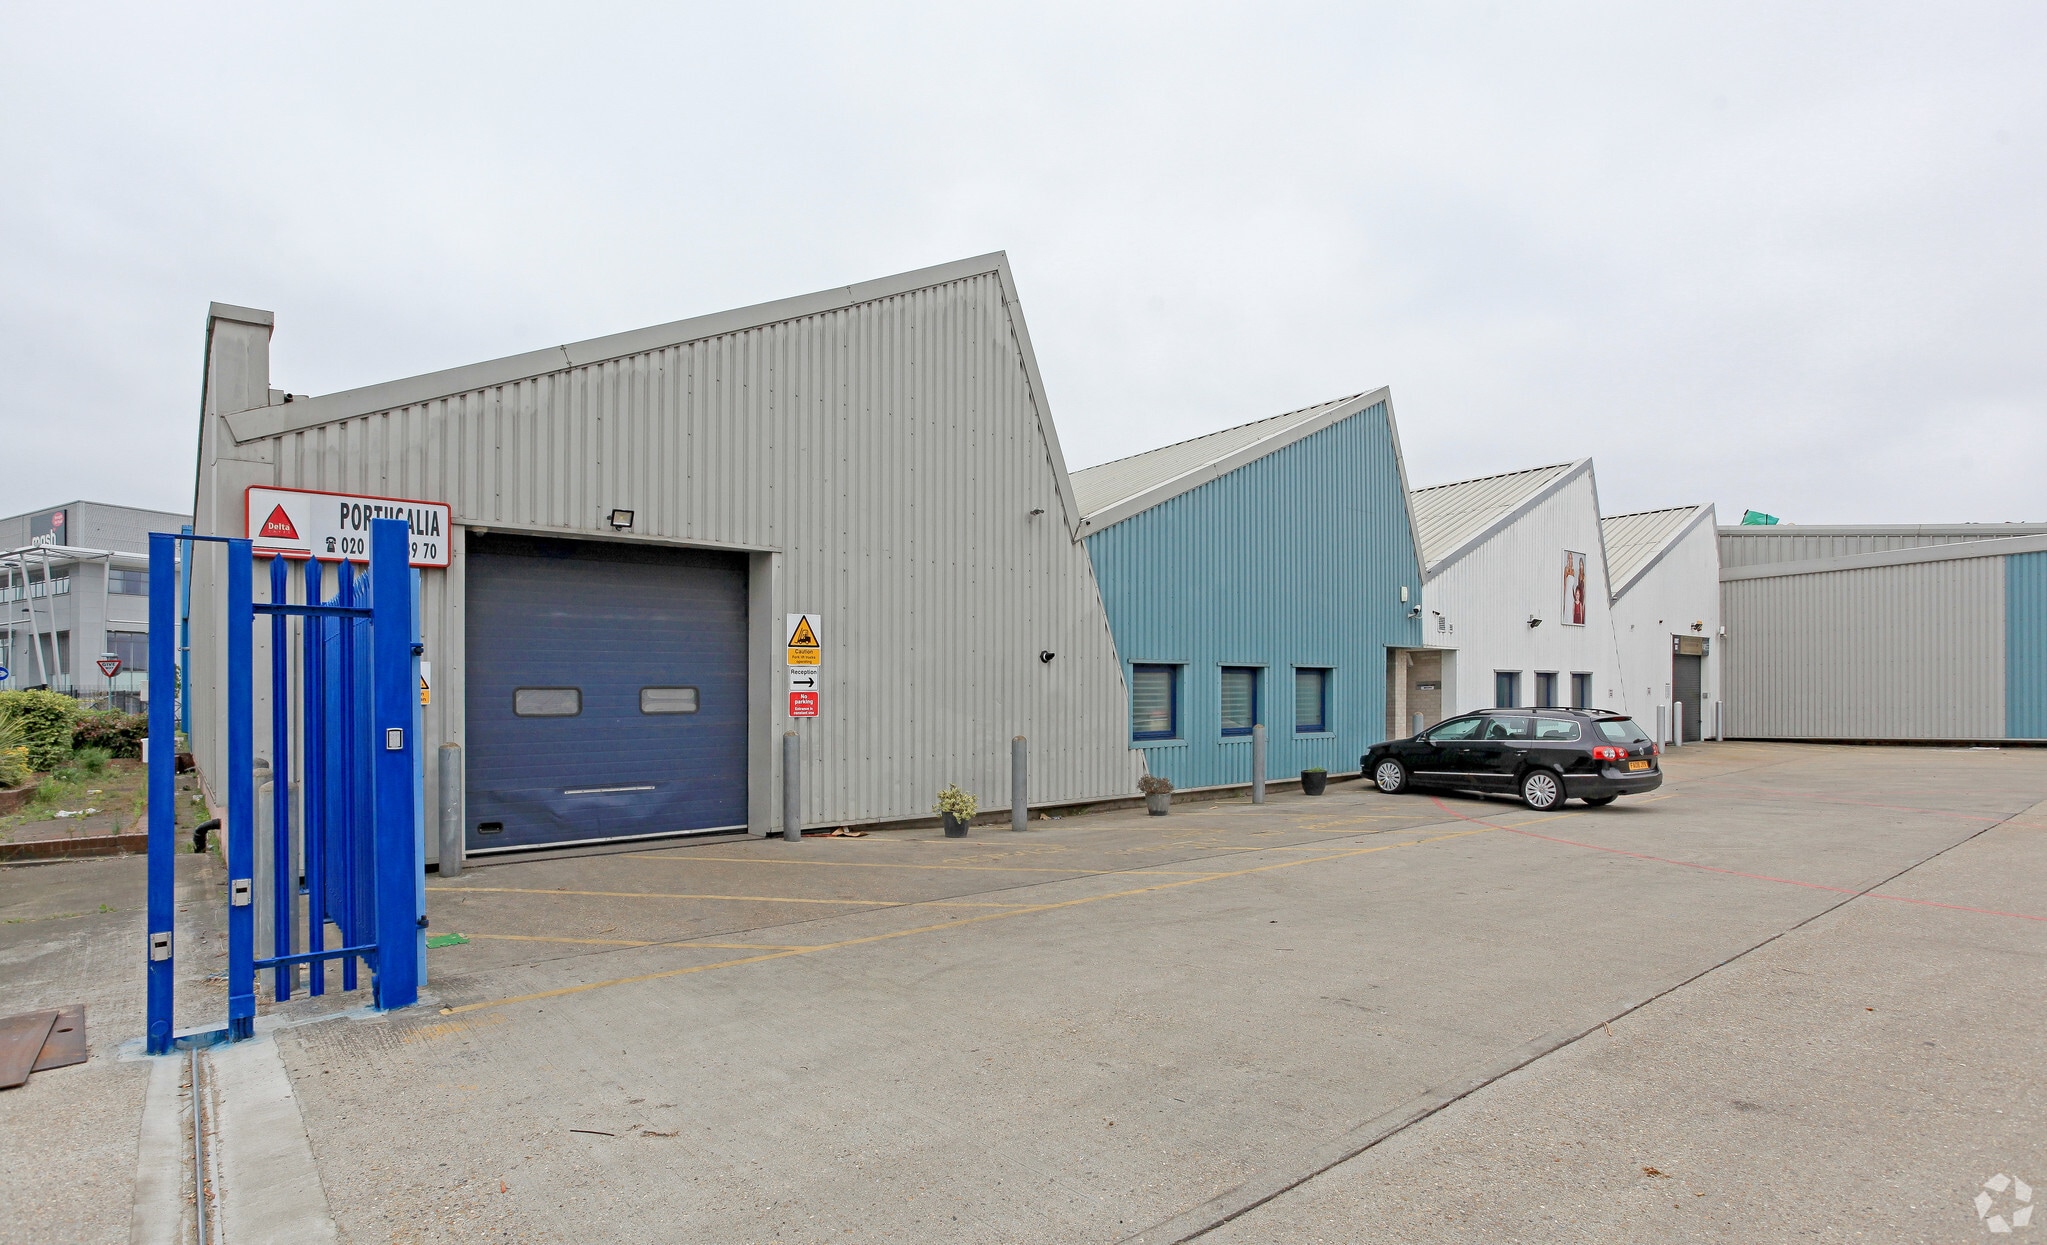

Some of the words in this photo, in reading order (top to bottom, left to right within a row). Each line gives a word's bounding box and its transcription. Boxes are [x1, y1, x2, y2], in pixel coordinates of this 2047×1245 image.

[268, 522, 291, 531] Delta
[341, 537, 365, 555] 020
[423, 543, 437, 560] 70
